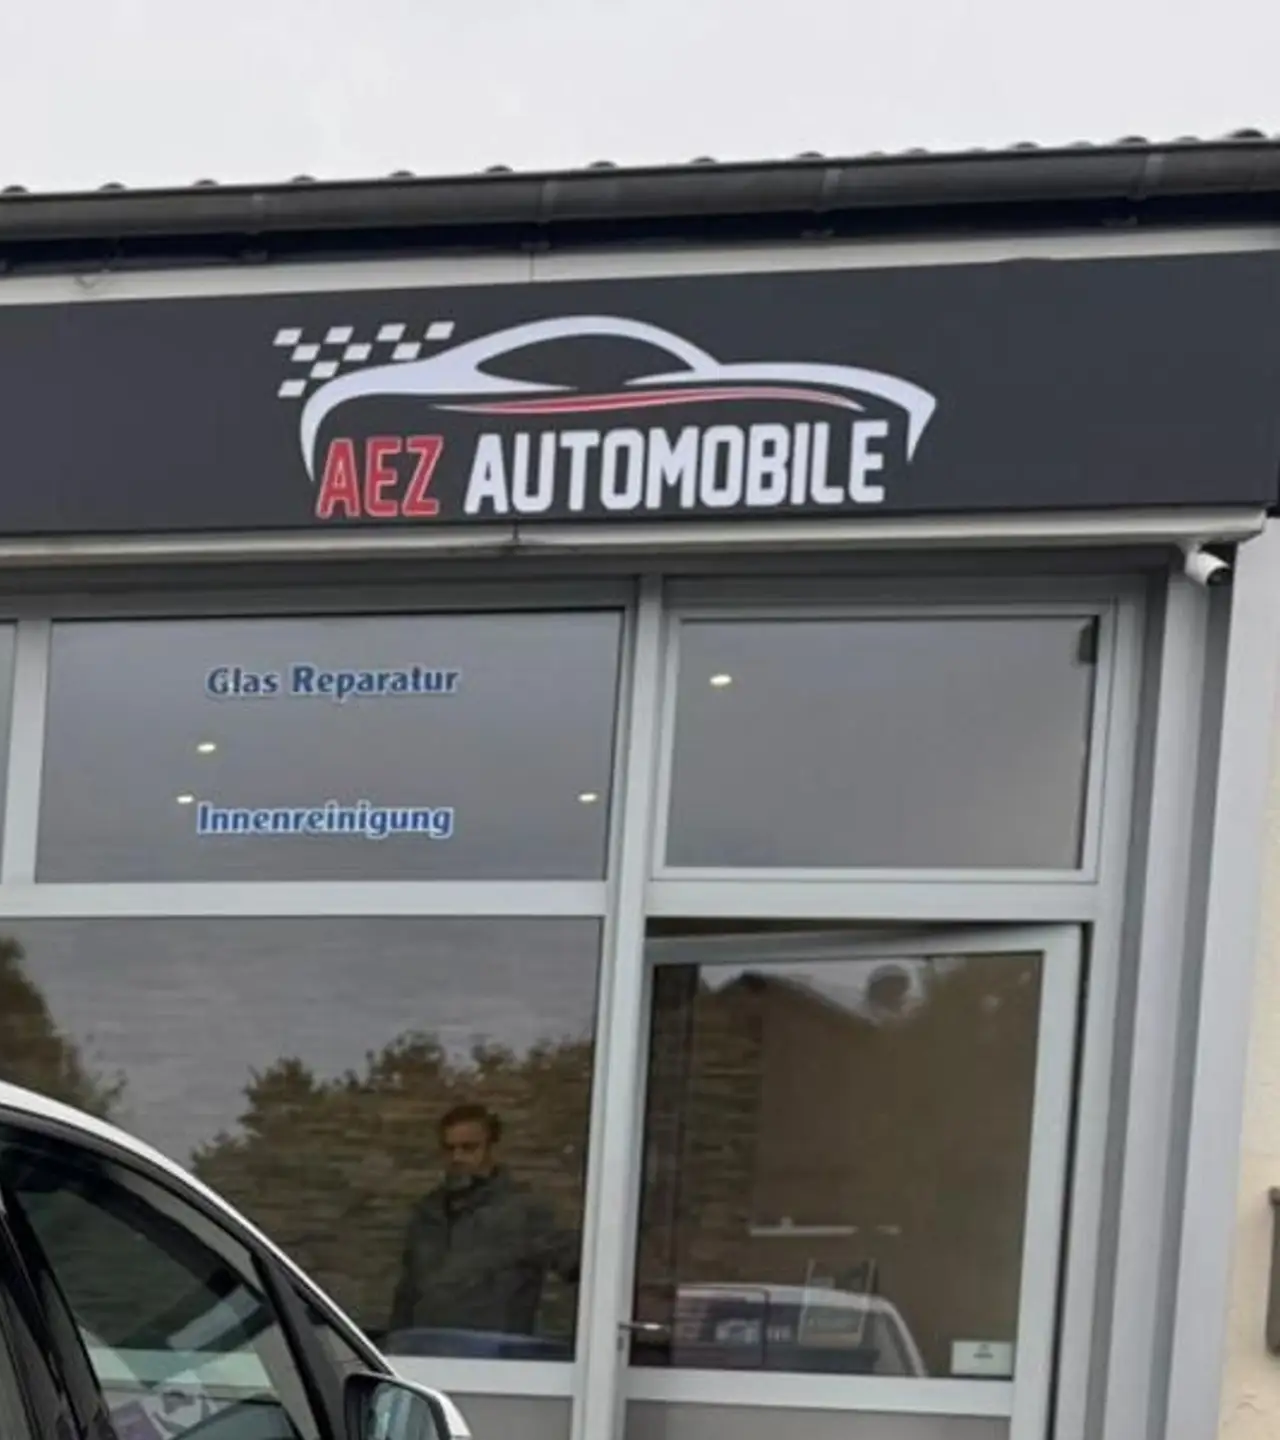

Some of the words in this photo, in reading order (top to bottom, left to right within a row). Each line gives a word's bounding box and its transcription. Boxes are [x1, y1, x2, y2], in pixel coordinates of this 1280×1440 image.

[315, 434, 443, 519] AEZ
[463, 419, 890, 515] AUTOMOBILE
[206, 665, 280, 696] Glas
[290, 664, 460, 702] Reparatur
[197, 801, 454, 838] Innenreinigung
